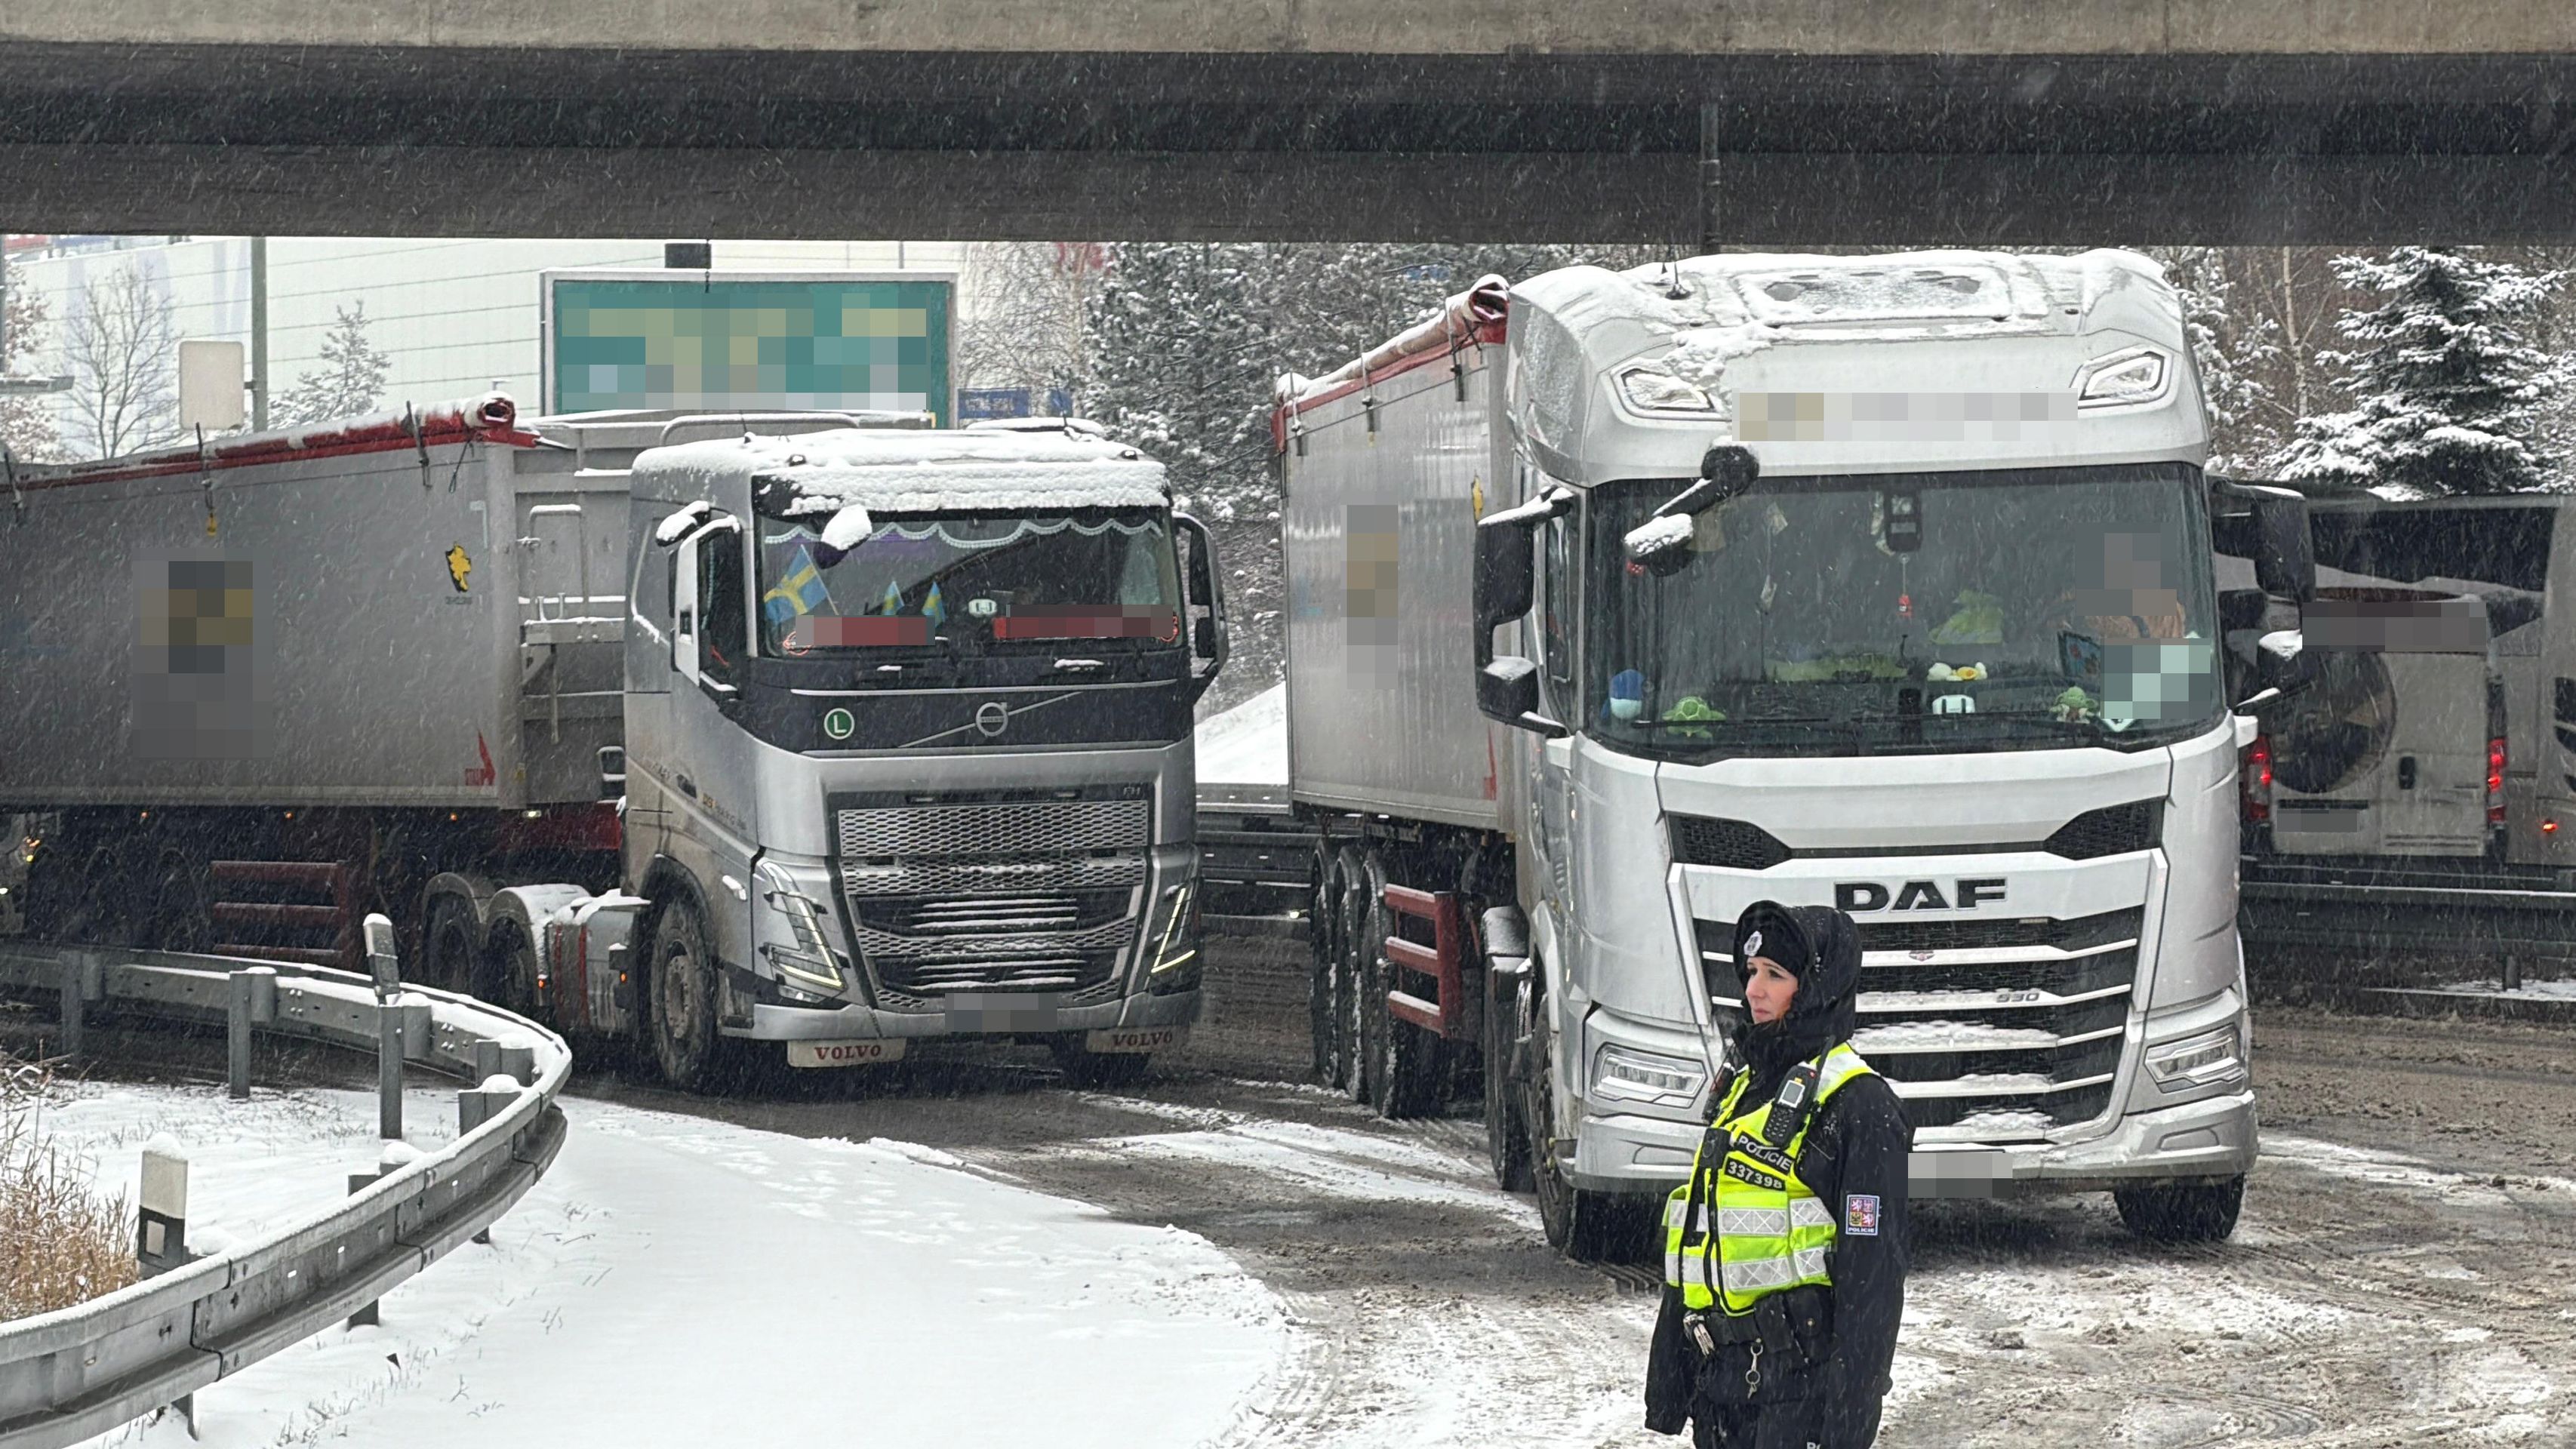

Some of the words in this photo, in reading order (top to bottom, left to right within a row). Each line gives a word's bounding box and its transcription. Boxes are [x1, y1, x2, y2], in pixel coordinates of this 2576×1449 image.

[833, 715, 847, 734] L
[1834, 877, 2007, 912] DAF
[1113, 1031, 1174, 1048] VOLVO
[815, 1044, 882, 1061] VOLVO
[1737, 1134, 1793, 1171] POLICIE
[1727, 1161, 1783, 1189] 337398
